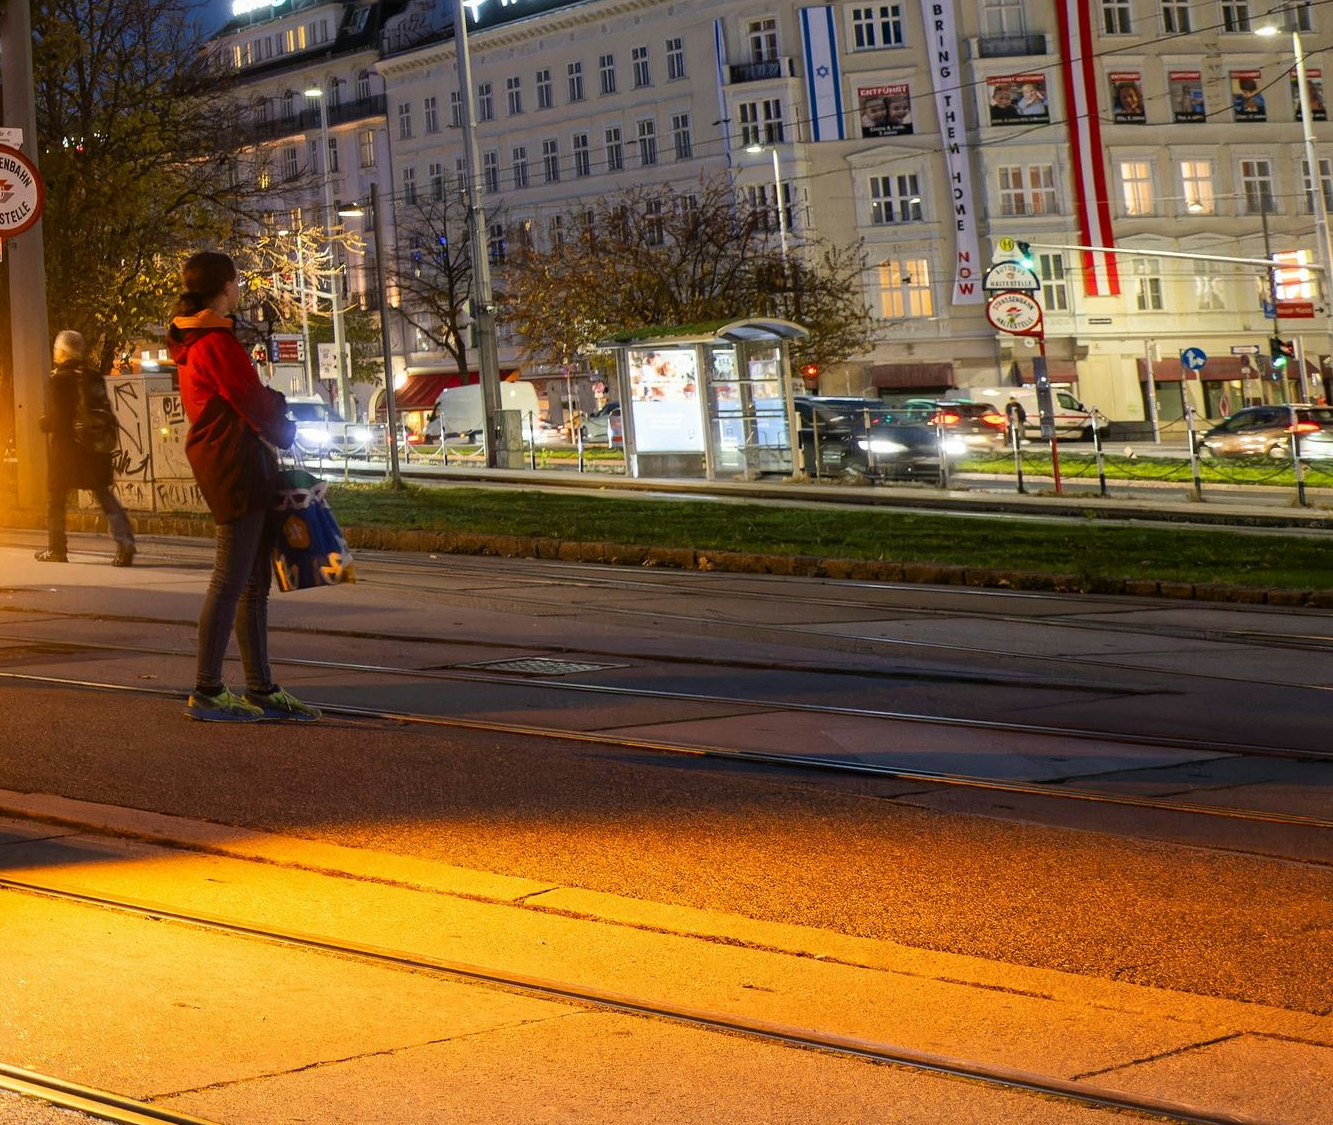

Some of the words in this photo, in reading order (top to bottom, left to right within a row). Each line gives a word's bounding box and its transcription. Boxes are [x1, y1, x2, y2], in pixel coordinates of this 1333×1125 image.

[933, 4, 951, 78] BRING
[958, 251, 975, 295] NOW
[996, 265, 1026, 276] AUTOBUS
[993, 296, 1034, 310] STRASSENBAHN
[996, 317, 1033, 329] HALTESTELLE
